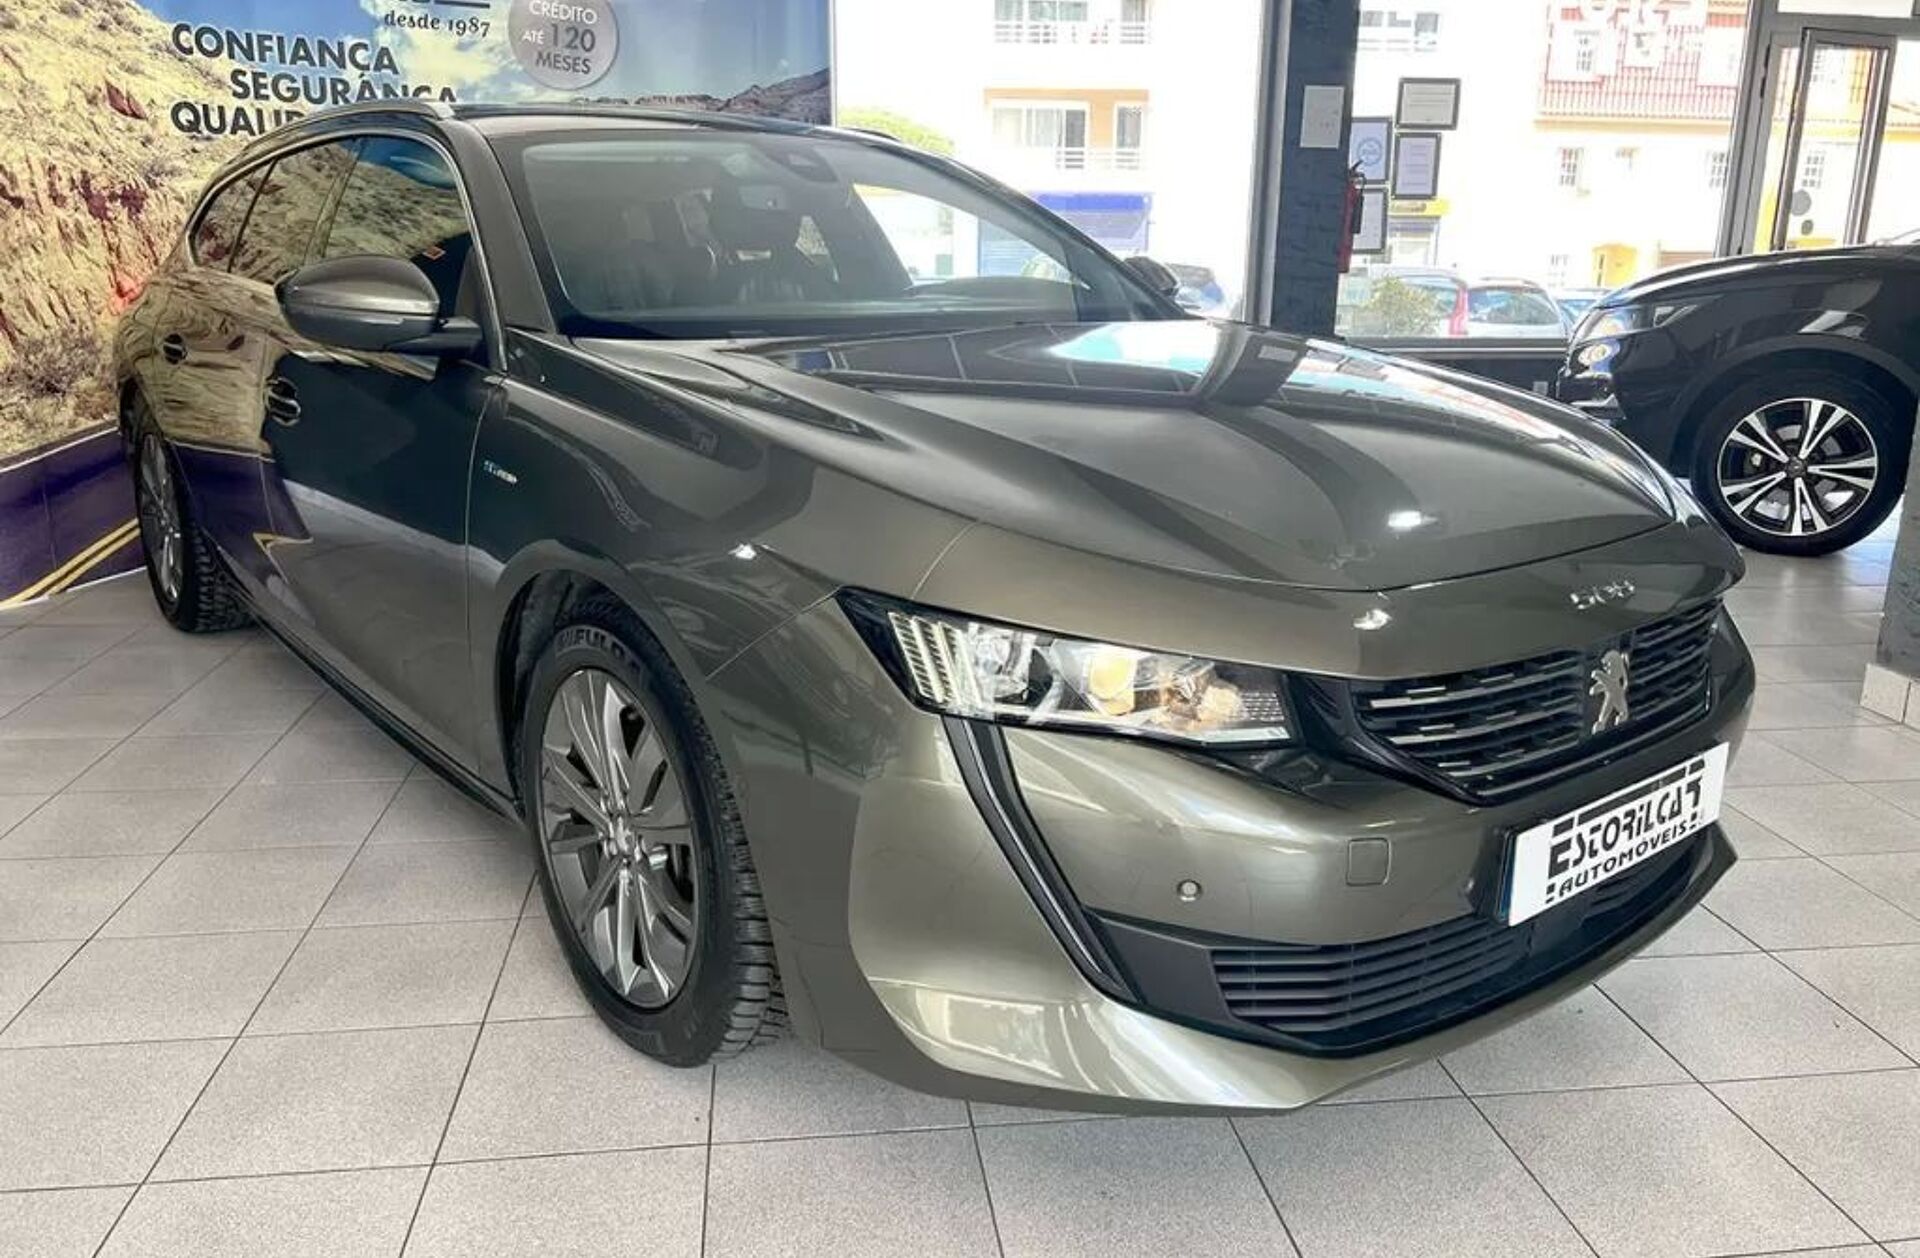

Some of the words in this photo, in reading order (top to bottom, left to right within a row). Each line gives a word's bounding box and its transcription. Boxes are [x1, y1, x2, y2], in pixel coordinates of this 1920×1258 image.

[384, 10, 440, 31] desde
[448, 15, 491, 38] 1987
[521, 30, 546, 45] ATÉ
[551, 23, 596, 52] 120
[171, 23, 399, 79] CONFIANÇA
[535, 51, 591, 75] MESES
